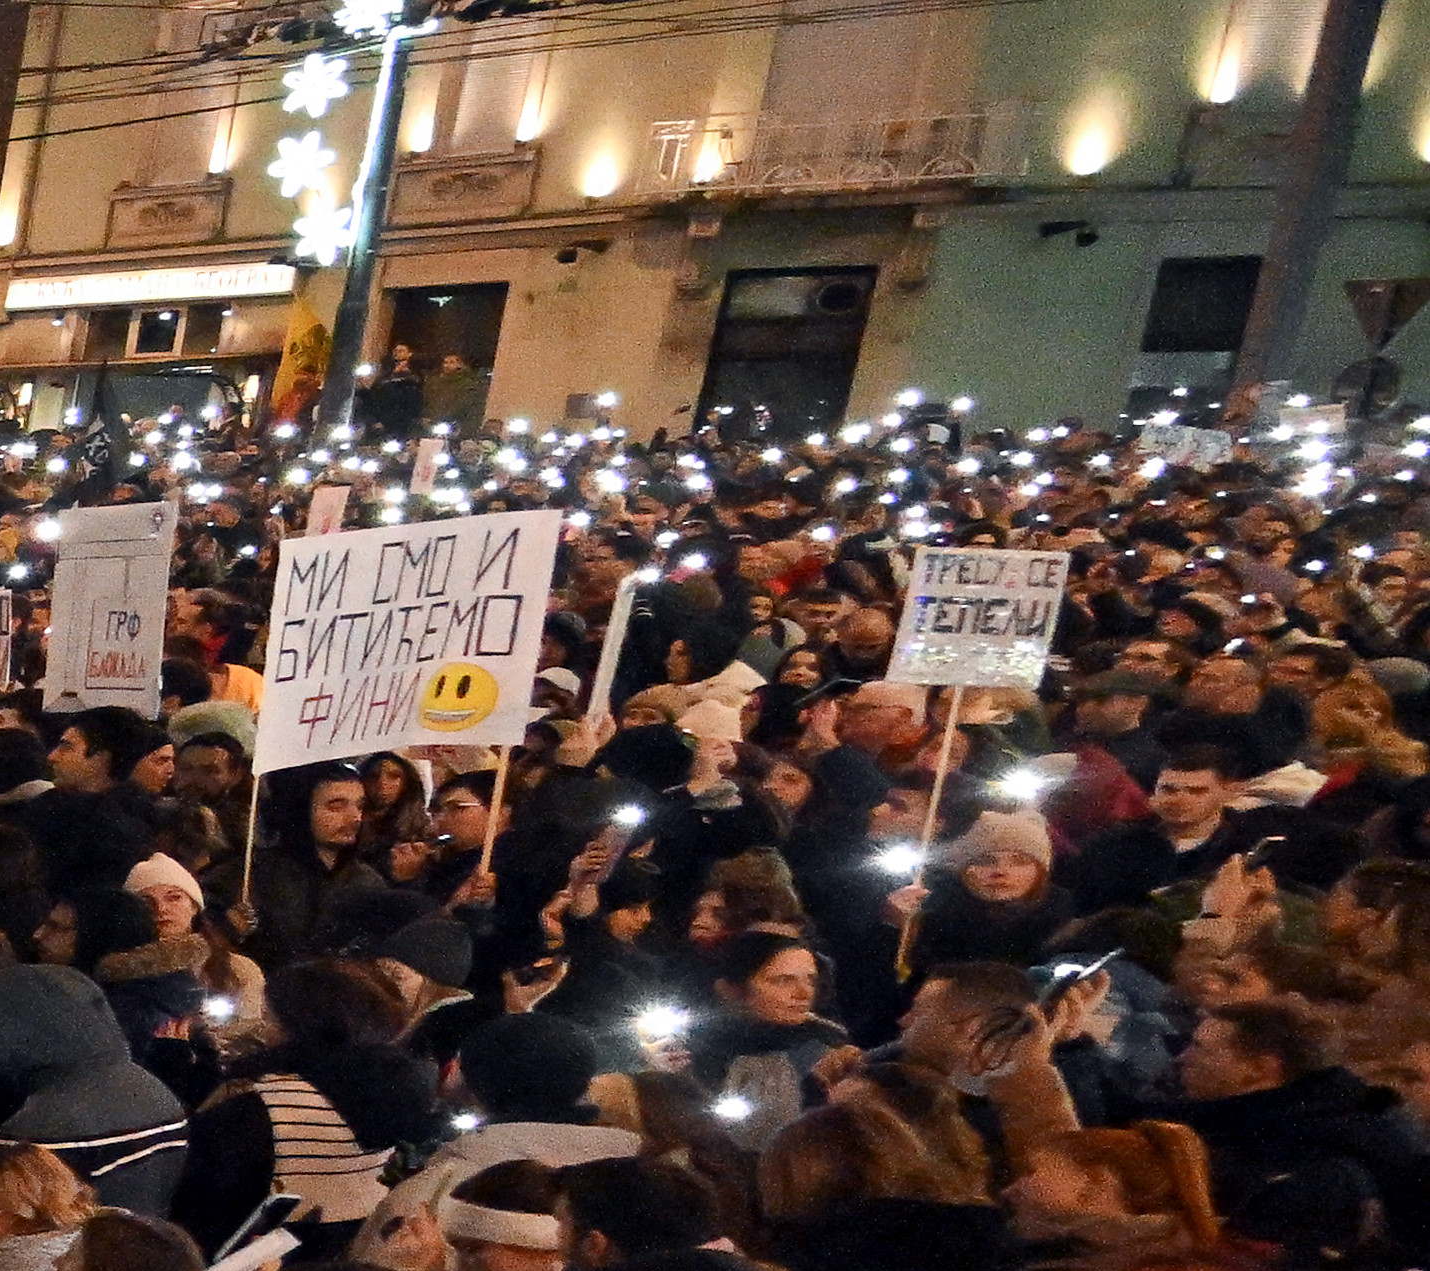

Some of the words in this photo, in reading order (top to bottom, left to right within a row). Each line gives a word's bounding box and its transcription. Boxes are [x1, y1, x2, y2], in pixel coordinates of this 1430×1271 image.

[284, 547, 351, 616] МИ
[372, 533, 457, 605] СМО
[472, 527, 521, 591] И
[1027, 557, 1064, 588] СЕ
[105, 610, 141, 642] ГРФ
[275, 594, 524, 684] БИТИЋЕМО
[298, 667, 423, 749] ФИНИ
